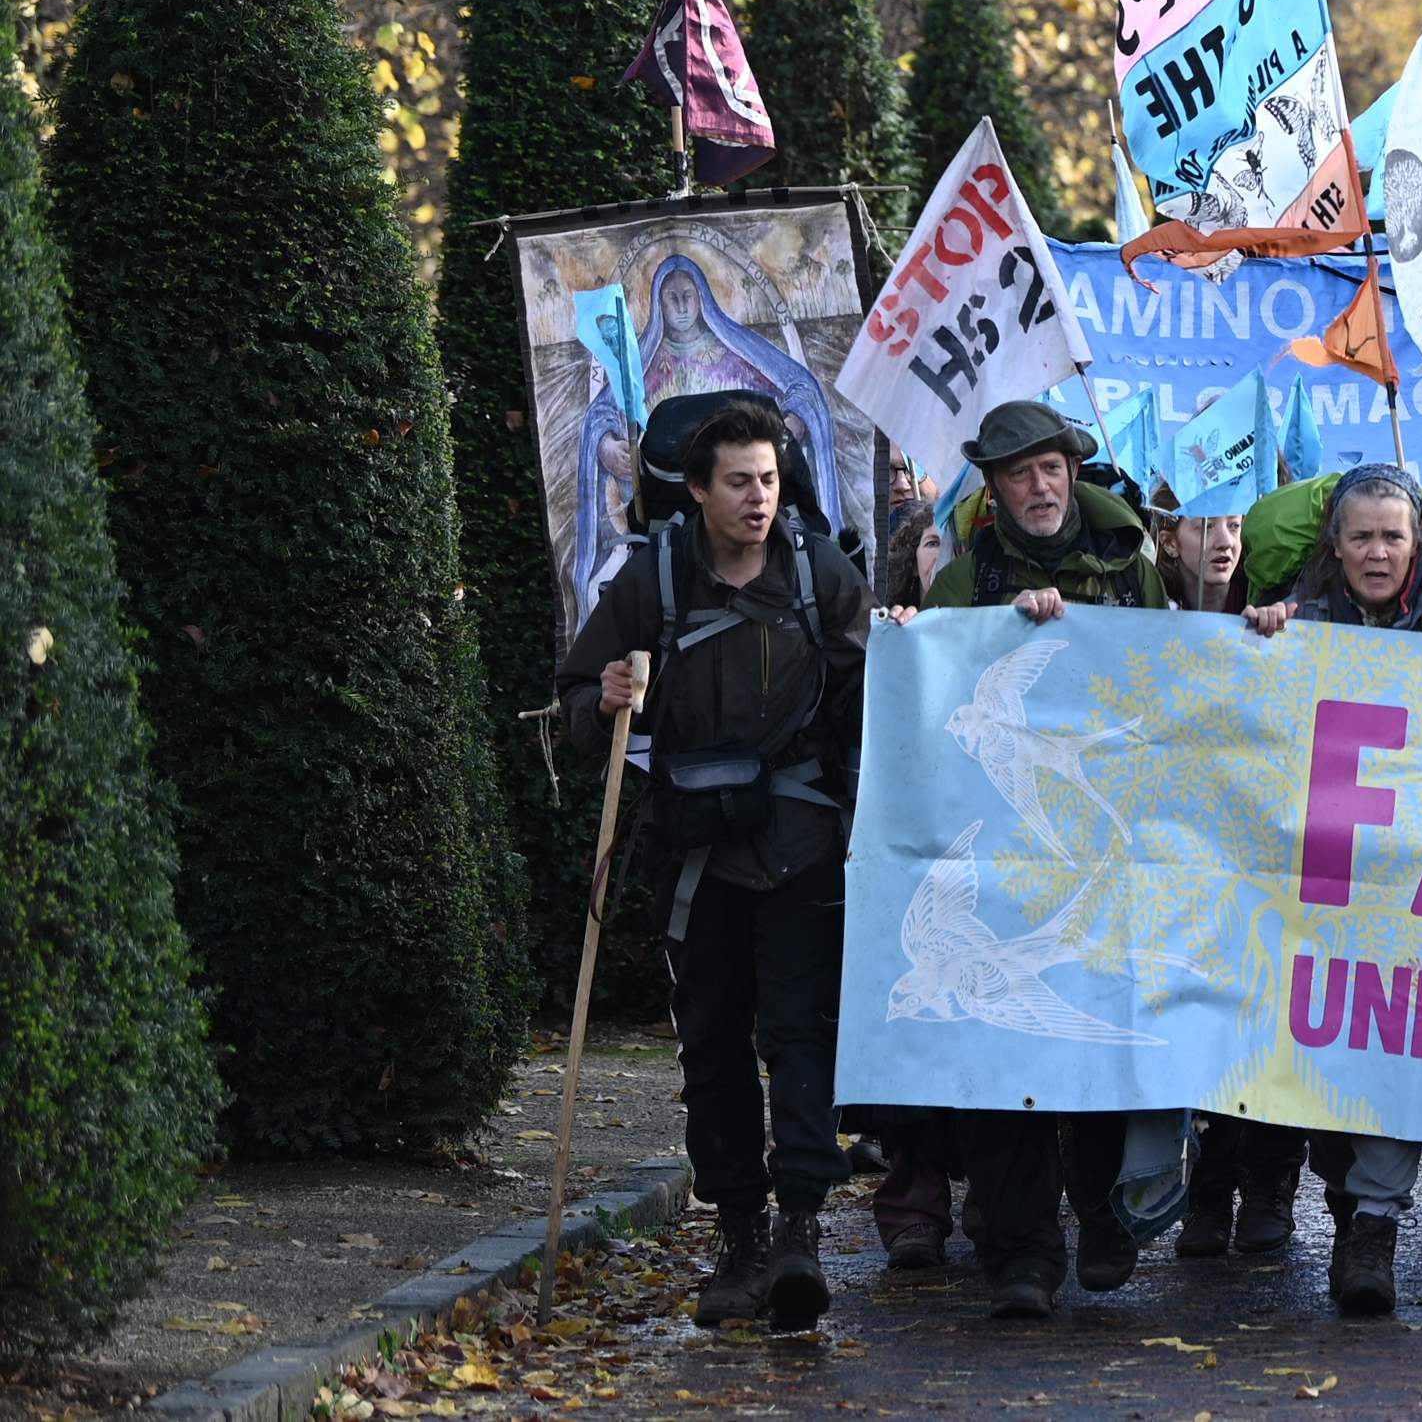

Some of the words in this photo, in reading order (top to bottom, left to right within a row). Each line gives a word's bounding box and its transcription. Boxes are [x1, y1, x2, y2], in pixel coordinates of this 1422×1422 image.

[688, 224, 731, 252] PRAY
[748, 260, 771, 289] FOR
[775, 300, 794, 327] US
[867, 163, 1014, 356] STOP
[1066, 271, 1316, 341] AMINO
